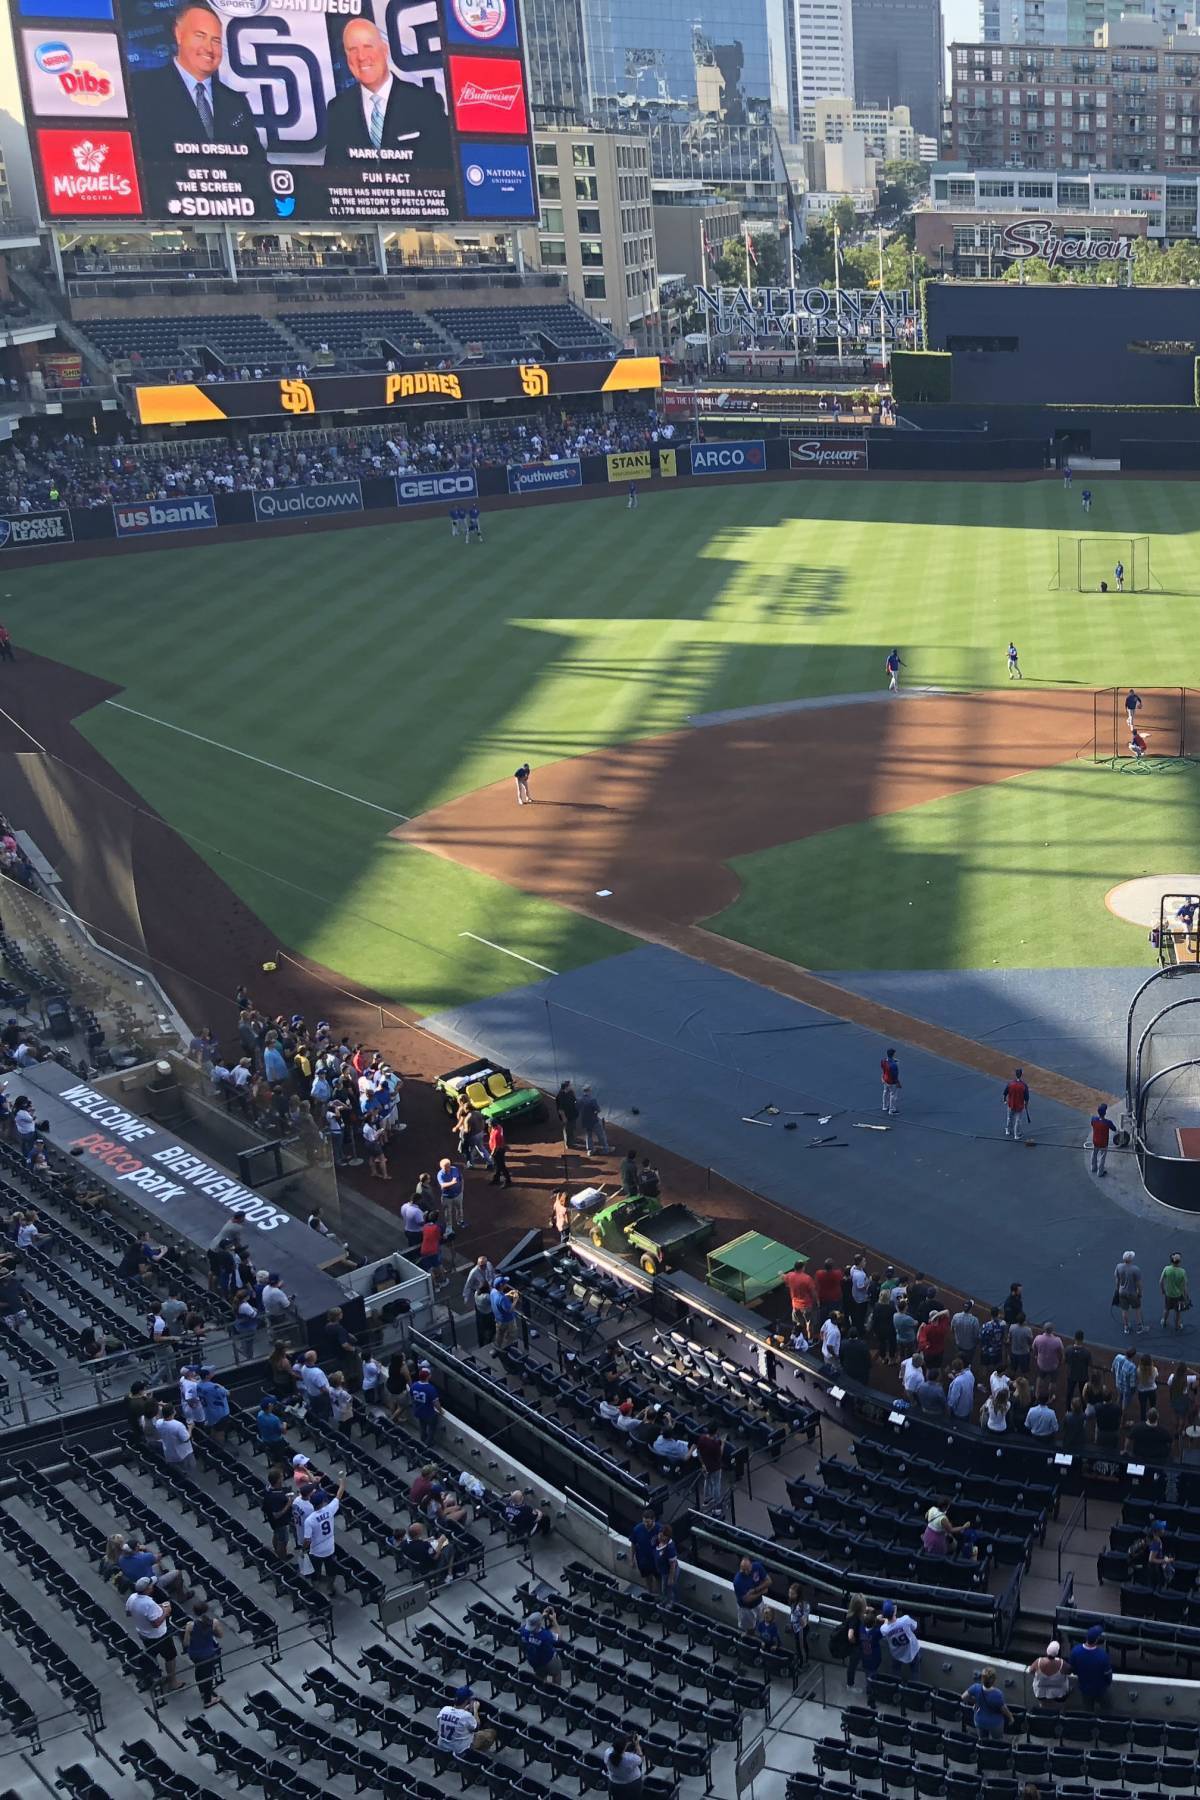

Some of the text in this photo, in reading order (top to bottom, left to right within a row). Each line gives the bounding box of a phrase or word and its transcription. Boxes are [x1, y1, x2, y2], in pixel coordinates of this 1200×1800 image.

[59, 69, 111, 96] Dibs
[462, 85, 515, 102] Budweiser
[175, 143, 249, 155] DON ORSILLO
[349, 148, 413, 160] MARK GRANT
[187, 169, 227, 180] GET ON
[362, 172, 410, 184] FUN FACT
[486, 168, 527, 178] NATIONAL
[176, 181, 242, 193] THE SCREEN
[328, 187, 446, 198] THERE HAS NEVER BEEN A CYCLE
[357, 198, 389, 206] HISTORY
[391, 198, 400, 206] OF
[426, 199, 445, 207] PARK
[356, 207, 390, 215] REGULAR
[391, 207, 420, 216] SEASON
[422, 207, 449, 217] GAMES)
[1002, 218, 1137, 270] Sycuan
[694, 284, 919, 318] NATIONAL
[713, 315, 902, 339] UNIVERSITY
[385, 372, 462, 405] PADRES
[612, 454, 669, 469] STANLY
[694, 450, 745, 467] ARCO
[797, 442, 860, 465] Sycuan
[516, 468, 569, 484] outhwest
[400, 476, 474, 498] GEICO
[259, 492, 359, 516] Qualcomm
[10, 516, 63, 531] ROCKET
[13, 529, 65, 542] LEAGUE
[58, 1084, 156, 1143] WELCOME
[151, 1145, 290, 1231] BIENVENIDOS
[321, 1521, 331, 1535] 9
[441, 1724, 456, 1740] 17
